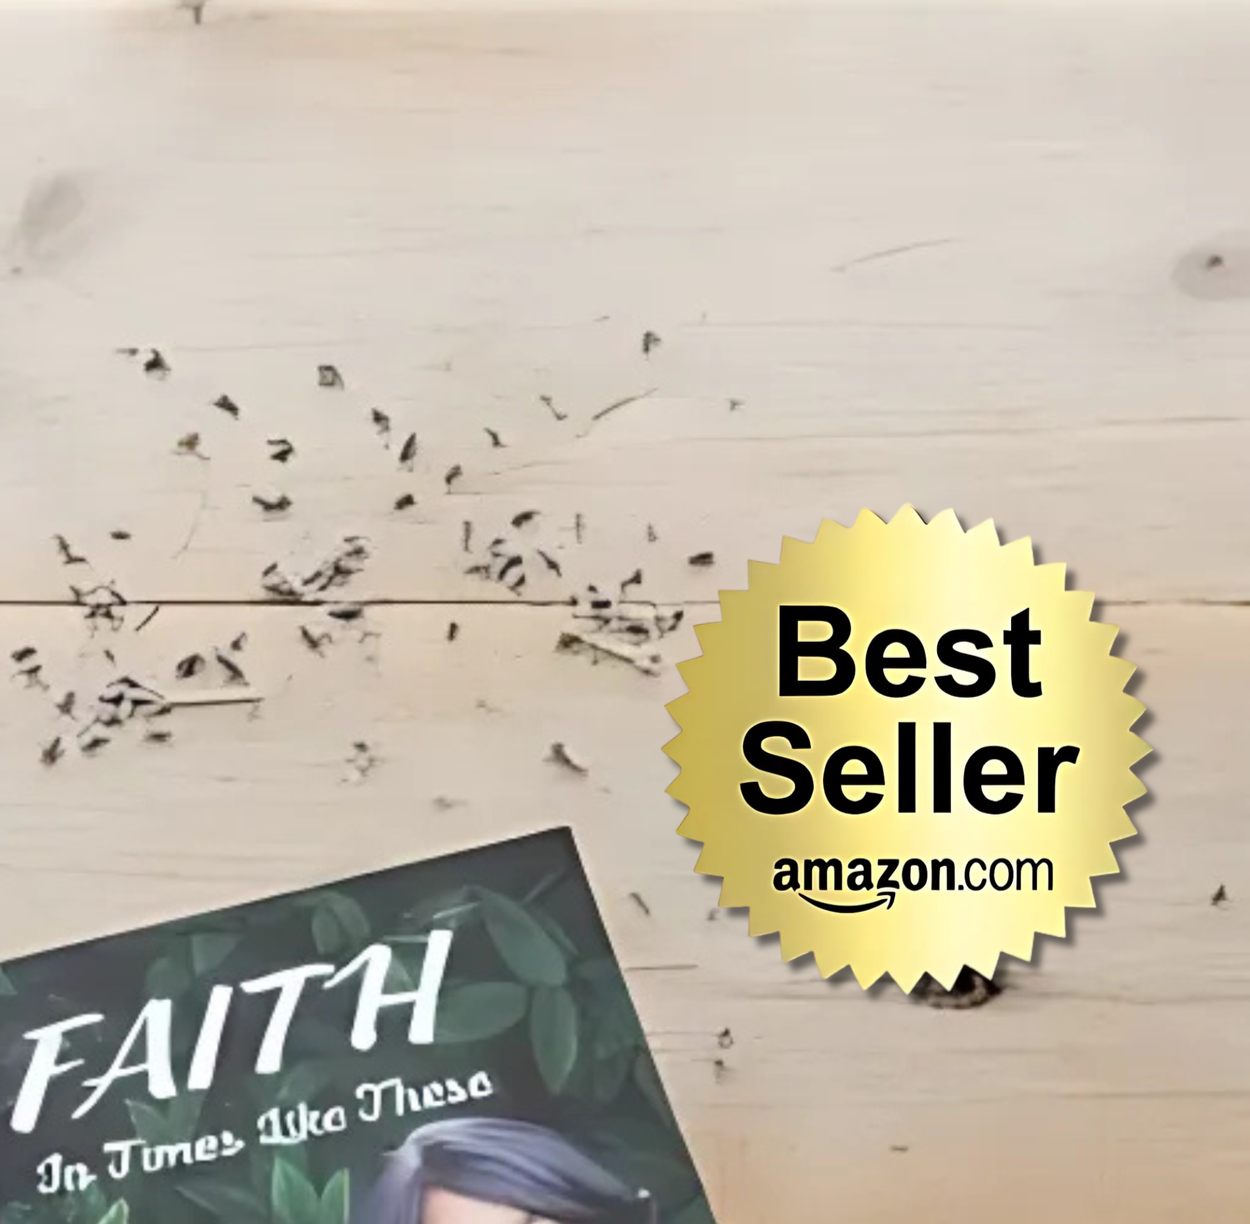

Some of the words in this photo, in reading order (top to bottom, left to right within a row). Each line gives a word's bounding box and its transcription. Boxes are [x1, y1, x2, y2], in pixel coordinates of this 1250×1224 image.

[9, 930, 453, 1134] FAITH
[36, 1152, 97, 1195] In
[102, 1129, 245, 1179] Times
[256, 1102, 347, 1146] Like
[355, 1070, 494, 1123] These
